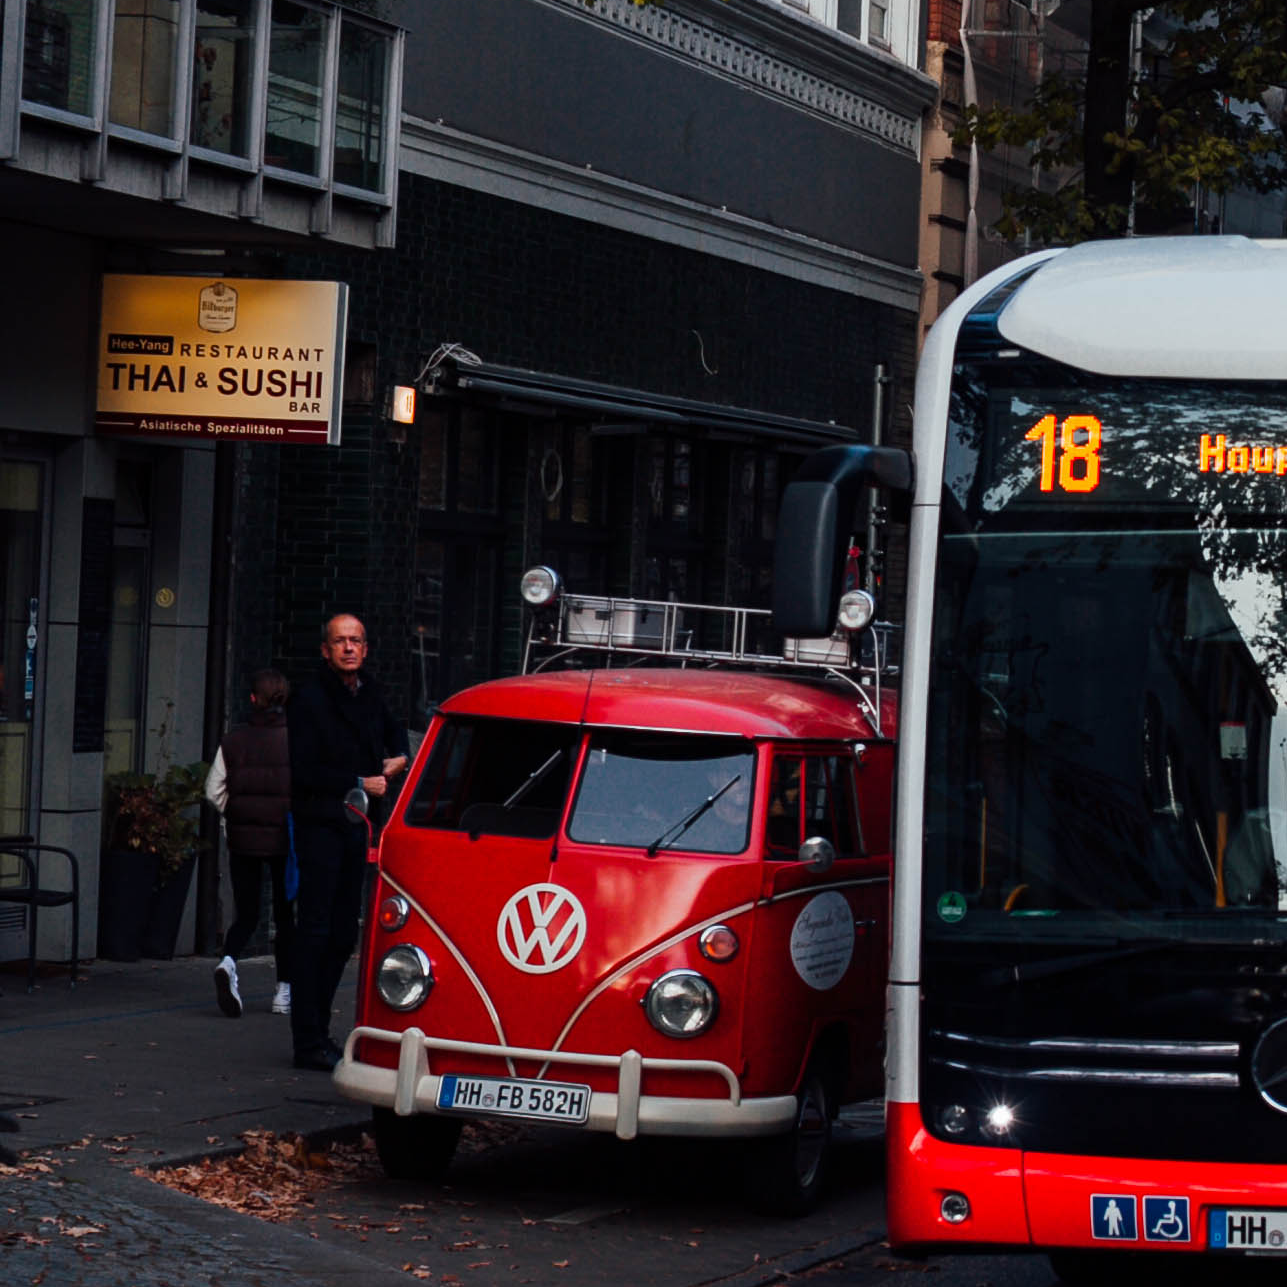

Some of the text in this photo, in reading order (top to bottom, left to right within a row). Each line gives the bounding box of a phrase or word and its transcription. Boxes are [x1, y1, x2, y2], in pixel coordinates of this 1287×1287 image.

[111, 337, 325, 362] Hee-Yang RESTAURANT
[106, 363, 323, 399] THAI & SUSHI
[288, 401, 321, 413] BAR
[139, 419, 284, 436] Asiatische Spezialitäten
[1024, 414, 1102, 492] 18
[499, 884, 585, 973] VW
[455, 1081, 583, 1115] HH FB 582H
[1228, 1215, 1266, 1245] HH
